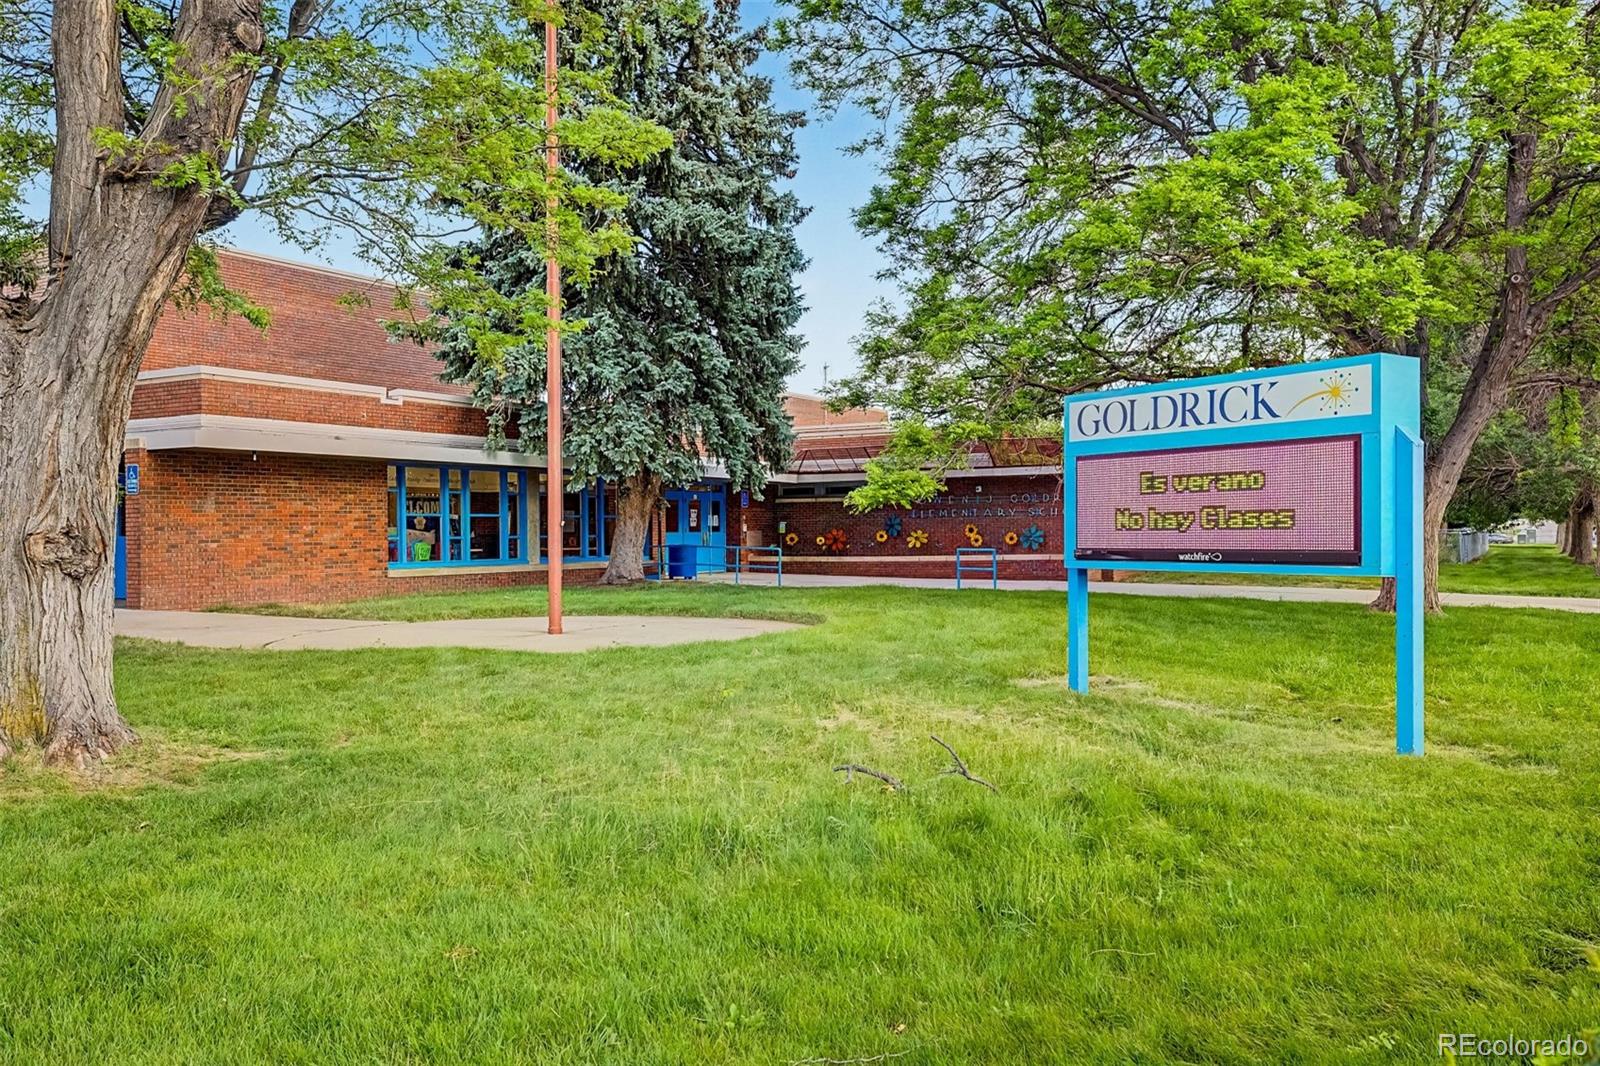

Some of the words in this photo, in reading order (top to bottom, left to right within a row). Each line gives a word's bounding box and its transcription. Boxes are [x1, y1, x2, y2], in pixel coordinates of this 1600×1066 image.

[1077, 381, 1281, 437] GOLDRICK
[1141, 472, 1167, 494] Es
[1172, 471, 1265, 493] verano
[1010, 493, 1060, 503] GOLDR
[1028, 507, 1058, 517] SCH
[1115, 508, 1143, 530] No
[1148, 508, 1194, 532] hay
[1200, 506, 1295, 530] Clases
[1178, 552, 1210, 561] watchfire
